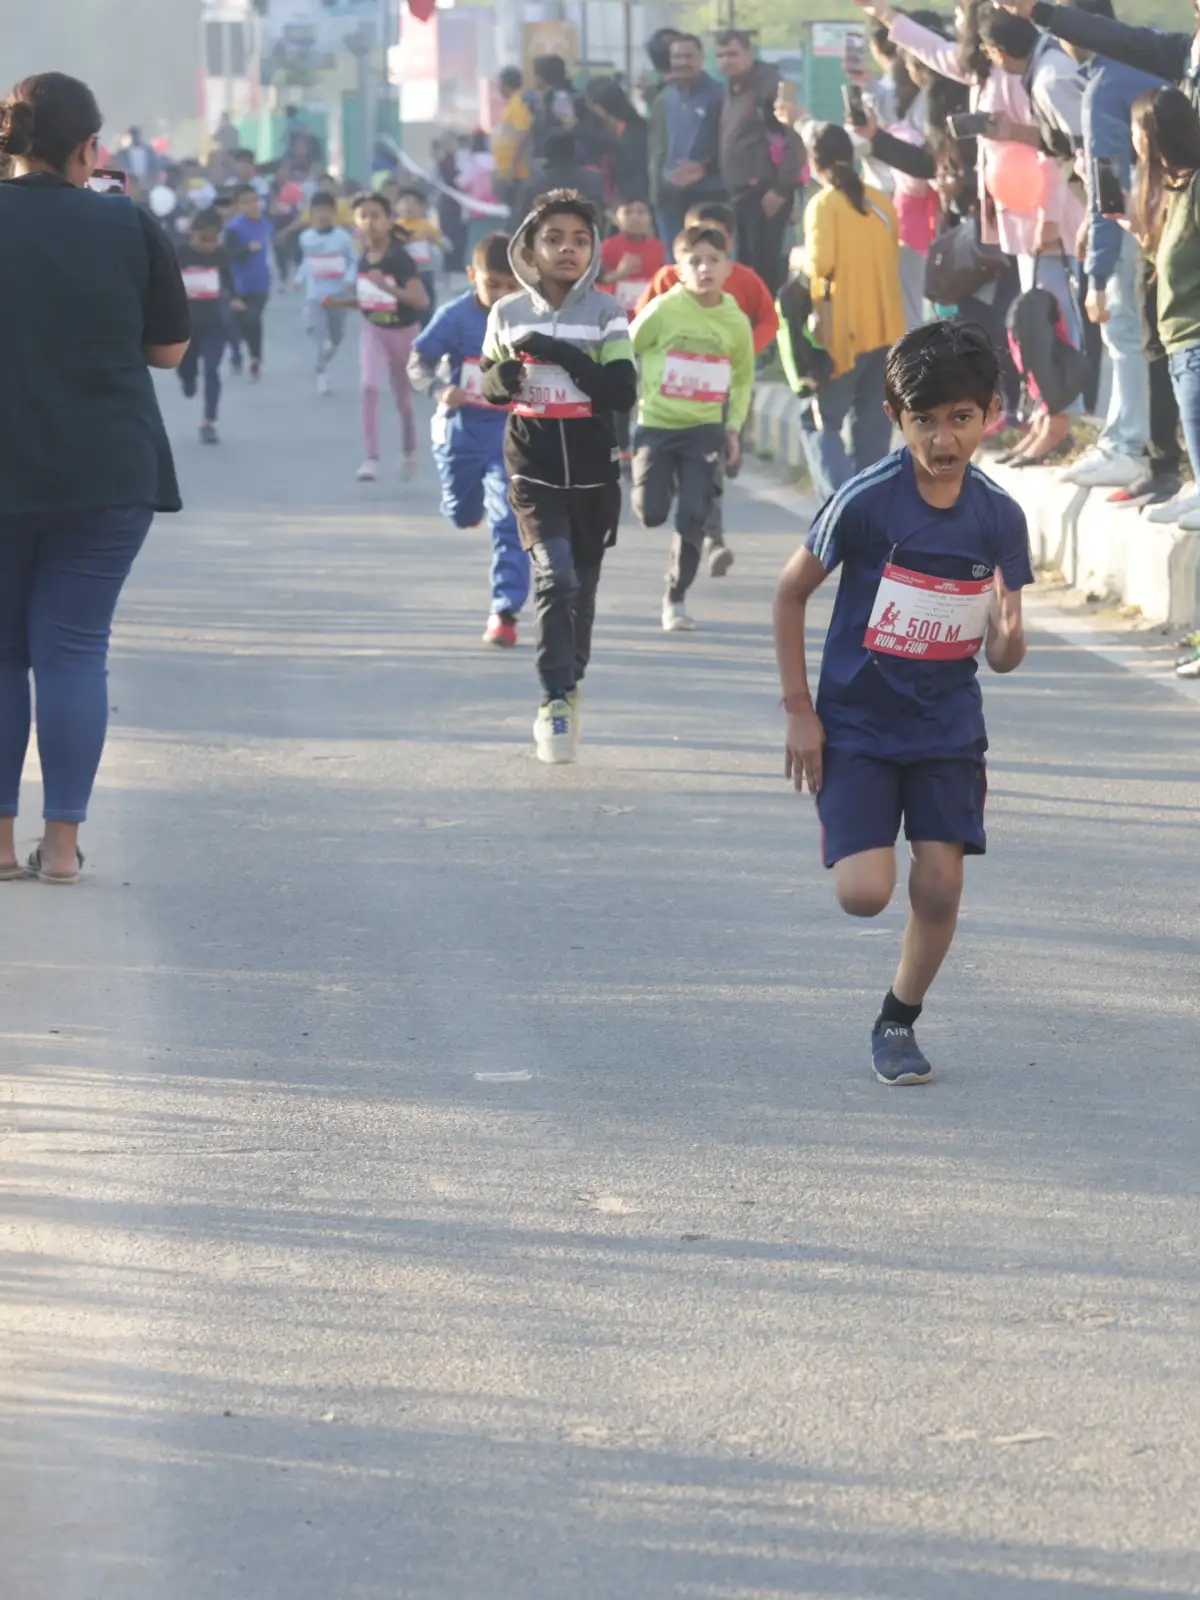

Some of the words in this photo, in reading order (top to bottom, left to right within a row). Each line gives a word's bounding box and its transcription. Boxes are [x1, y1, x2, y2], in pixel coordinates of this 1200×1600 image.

[555, 388, 567, 403] M
[905, 617, 942, 642] 500
[945, 624, 962, 642] M
[874, 634, 895, 649] RUN
[904, 640, 928, 656] FUN!
[884, 1027, 909, 1038] AIR
